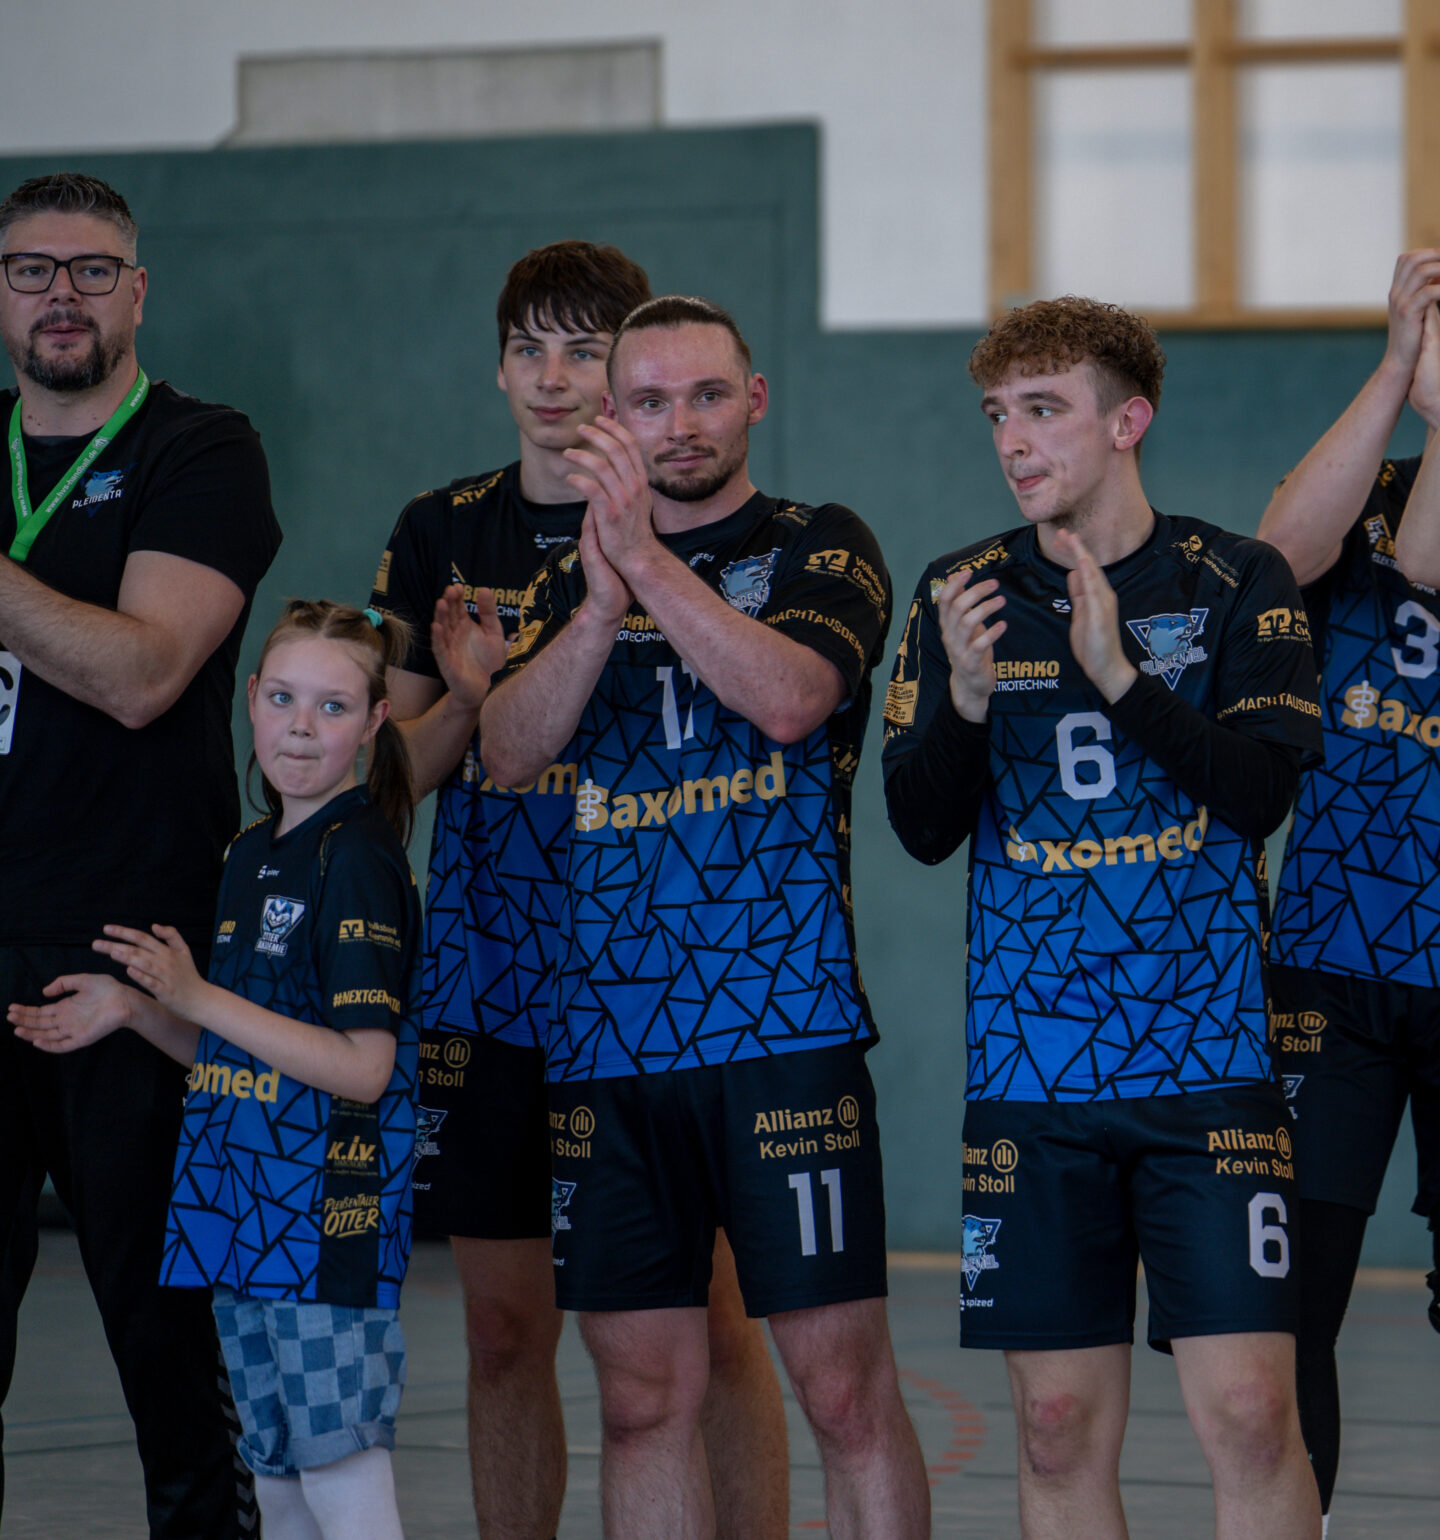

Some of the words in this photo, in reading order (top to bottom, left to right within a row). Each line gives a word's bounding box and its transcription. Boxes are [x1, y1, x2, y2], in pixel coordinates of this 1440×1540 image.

[957, 545, 1009, 576] THOS
[1056, 711, 1117, 801] 6
[576, 752, 787, 831] Saxomed
[1281, 1035, 1322, 1053] Stoll
[190, 1063, 281, 1103] omed
[426, 1068, 465, 1088] Stoll
[753, 1107, 834, 1135] Allianz
[556, 1138, 592, 1159] Stoll
[759, 1137, 819, 1159] Kevin
[824, 1130, 861, 1152] Stoll
[1207, 1128, 1276, 1153] Allianz
[1215, 1157, 1268, 1176] Kevin
[1271, 1160, 1295, 1181] Stoll
[978, 1174, 1015, 1194] Stoll
[324, 1208, 380, 1237] OTTER
[788, 1169, 846, 1256] 11
[1247, 1191, 1291, 1280] 6
